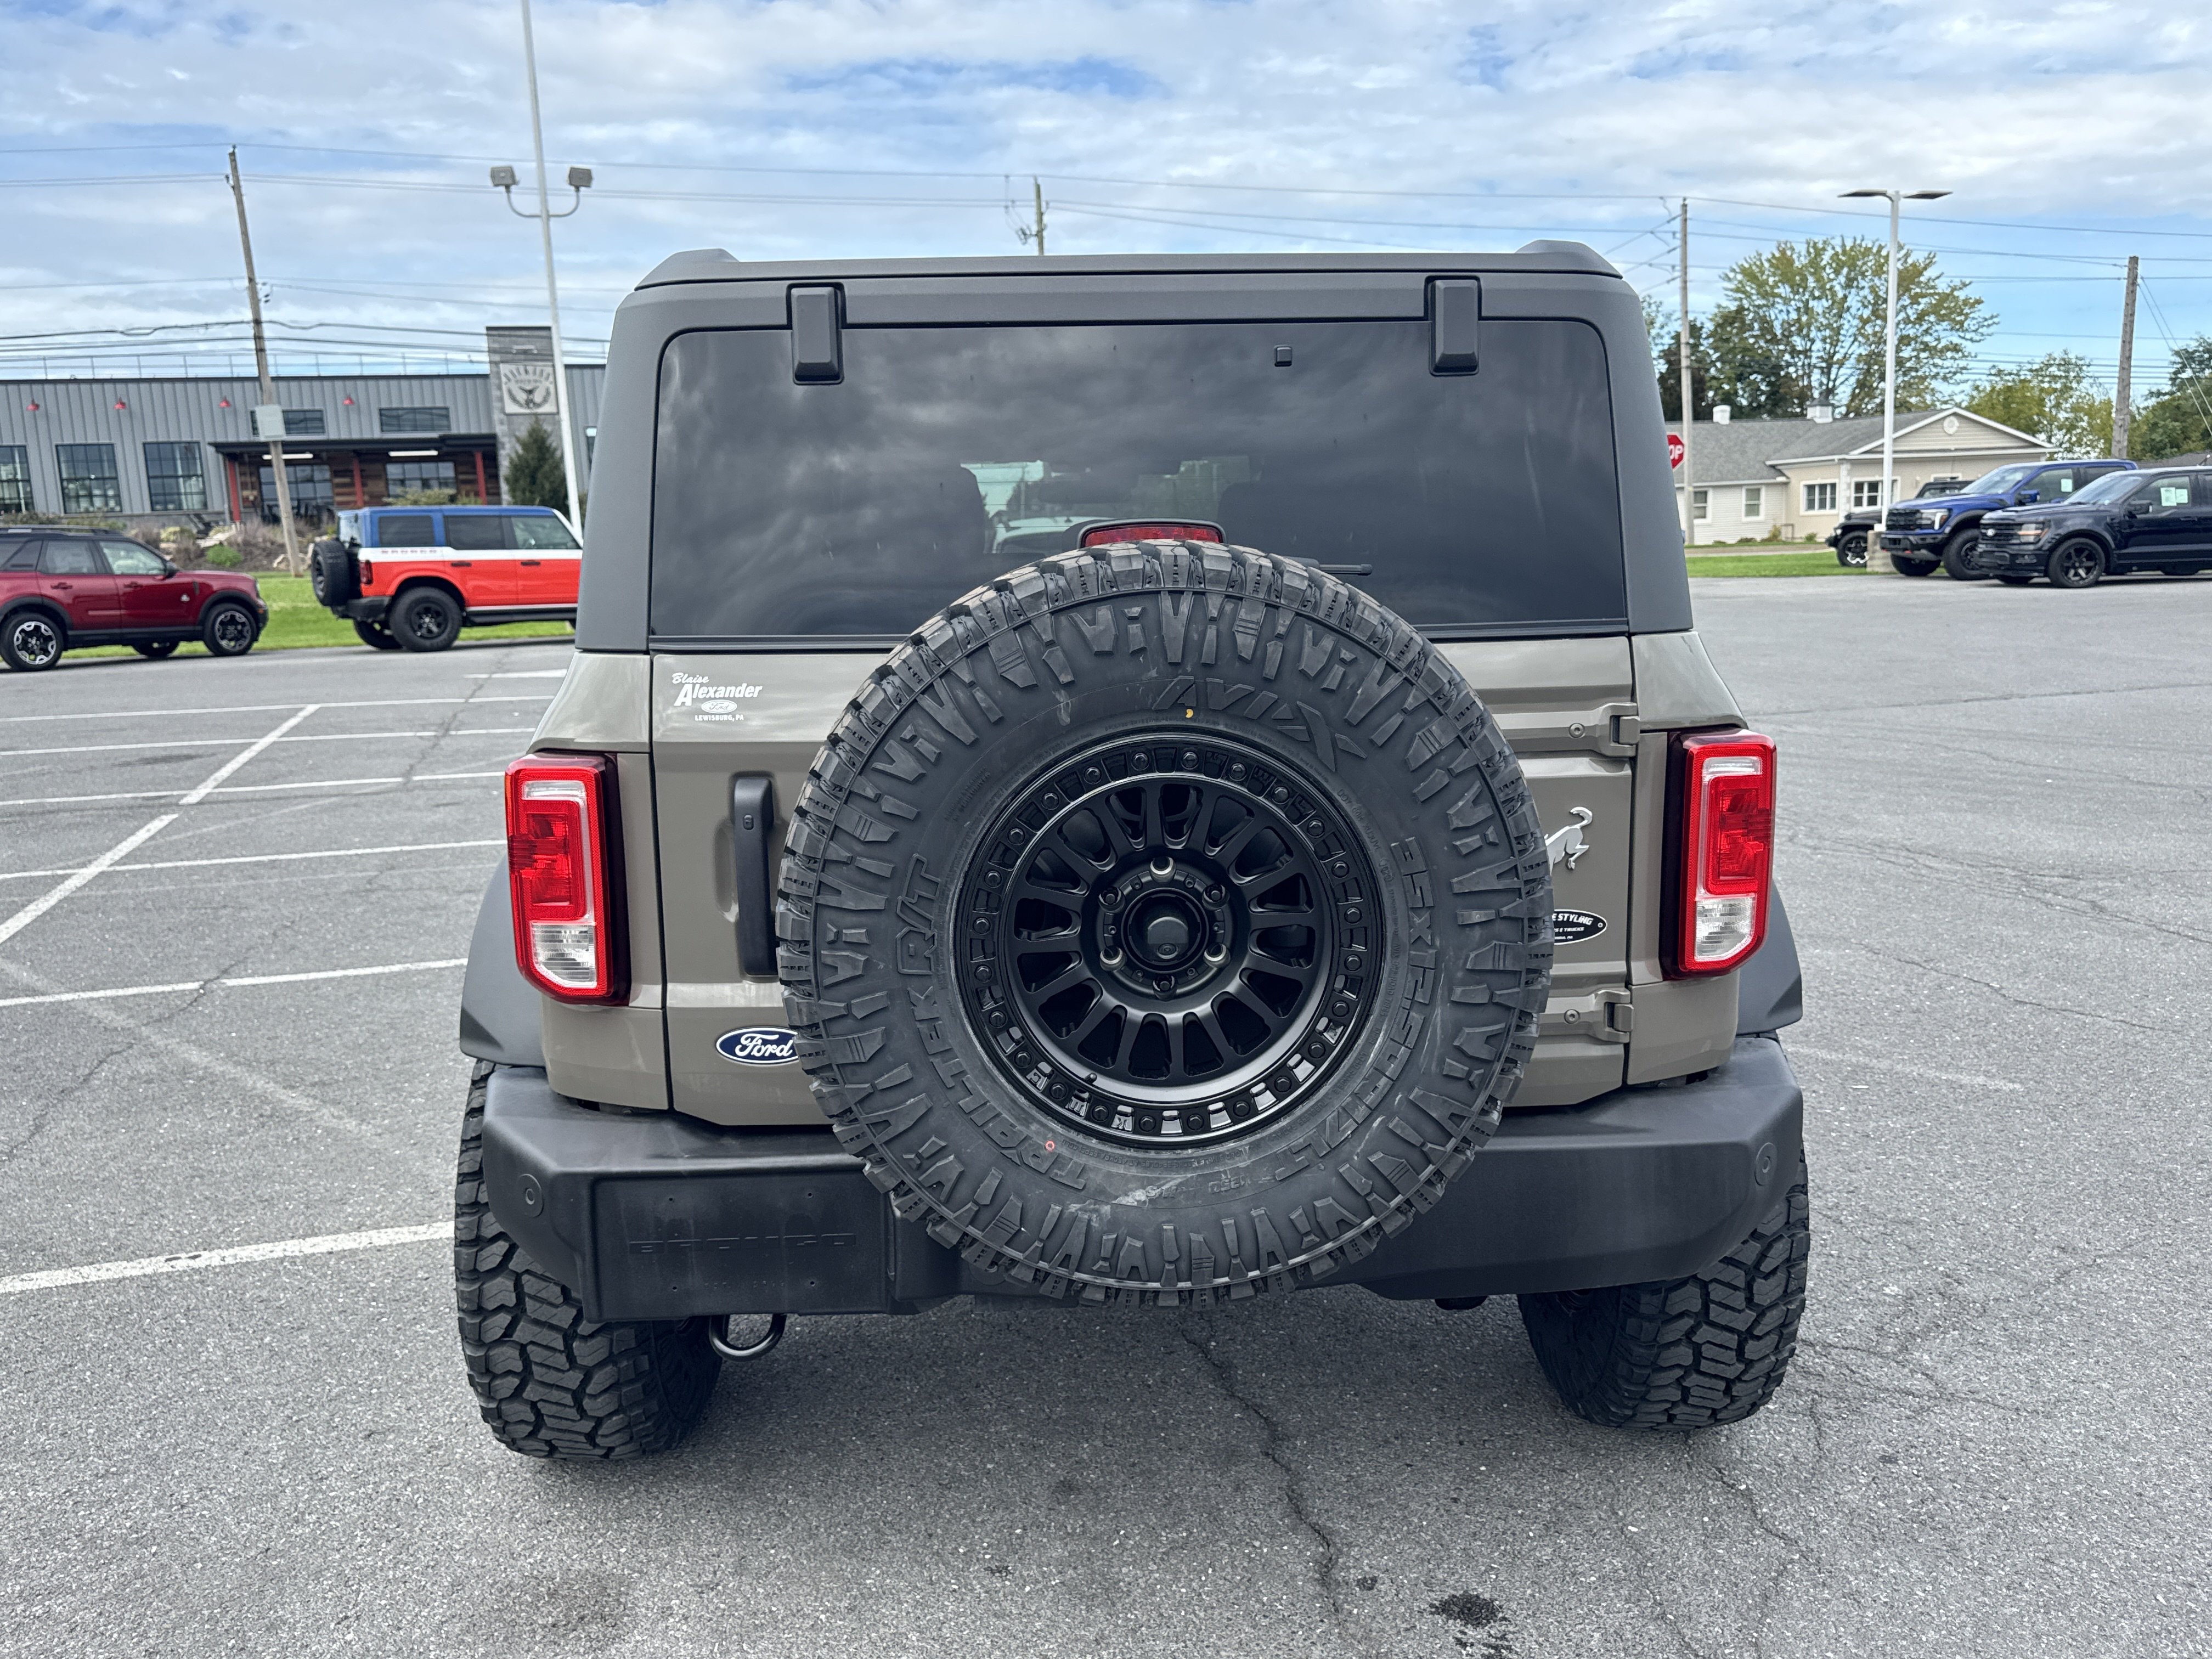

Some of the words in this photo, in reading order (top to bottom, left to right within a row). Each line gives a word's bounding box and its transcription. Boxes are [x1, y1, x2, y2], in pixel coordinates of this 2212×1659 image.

[1669, 444, 1683, 460] OP
[672, 672, 709, 684] Blaise
[674, 683, 763, 706] Alexander
[1558, 913, 1594, 926] STYLING
[735, 1033, 793, 1057] Ford
